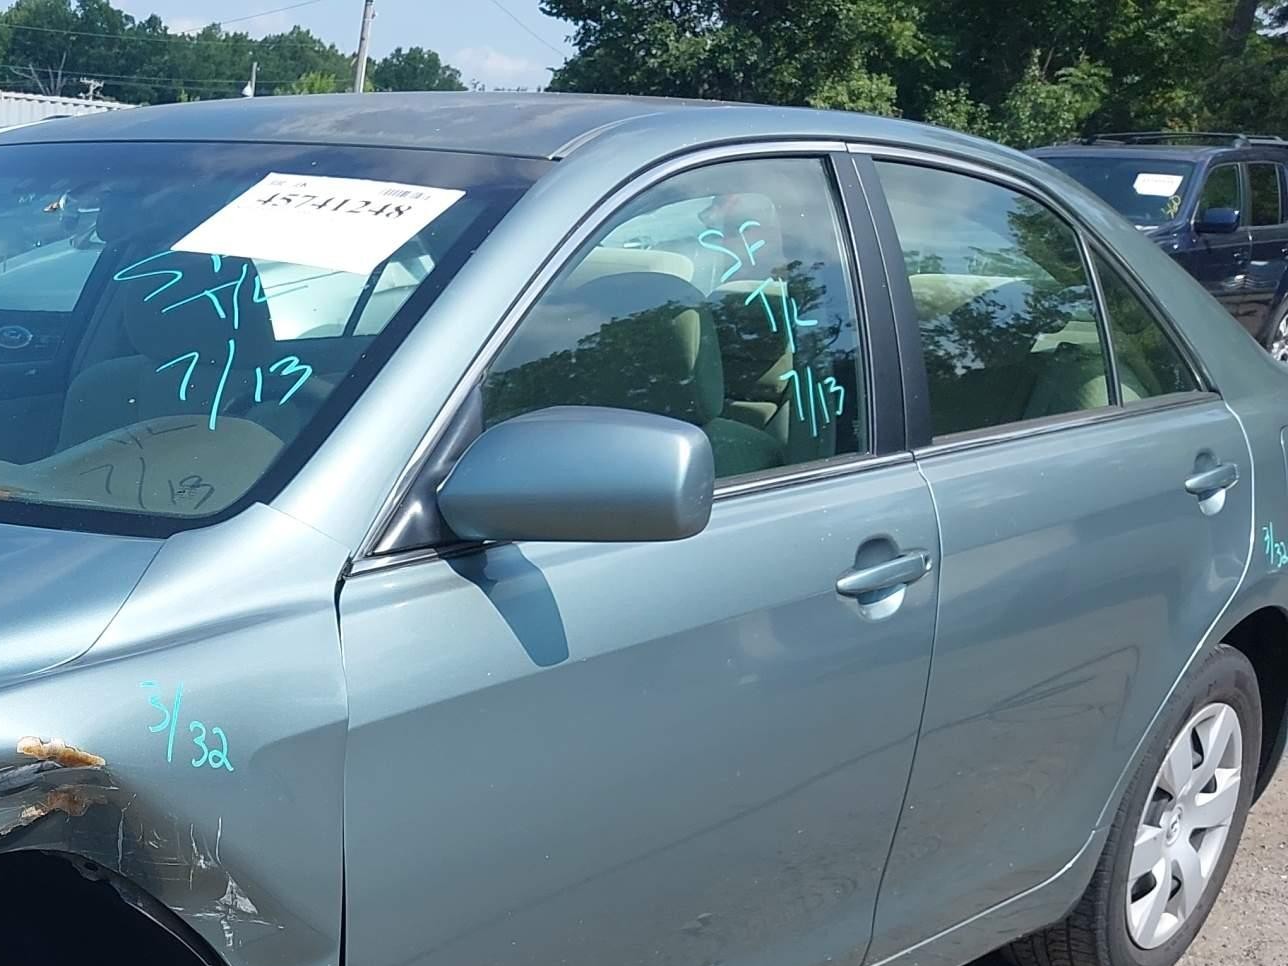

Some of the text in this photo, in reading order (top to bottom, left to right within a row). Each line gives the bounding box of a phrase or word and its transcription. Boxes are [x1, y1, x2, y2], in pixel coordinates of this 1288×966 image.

[256, 192, 413, 219] 45741248
[697, 220, 766, 283] SF
[155, 339, 313, 431] 7/13
[778, 366, 845, 437] 7/13
[137, 679, 235, 772] 5/32
